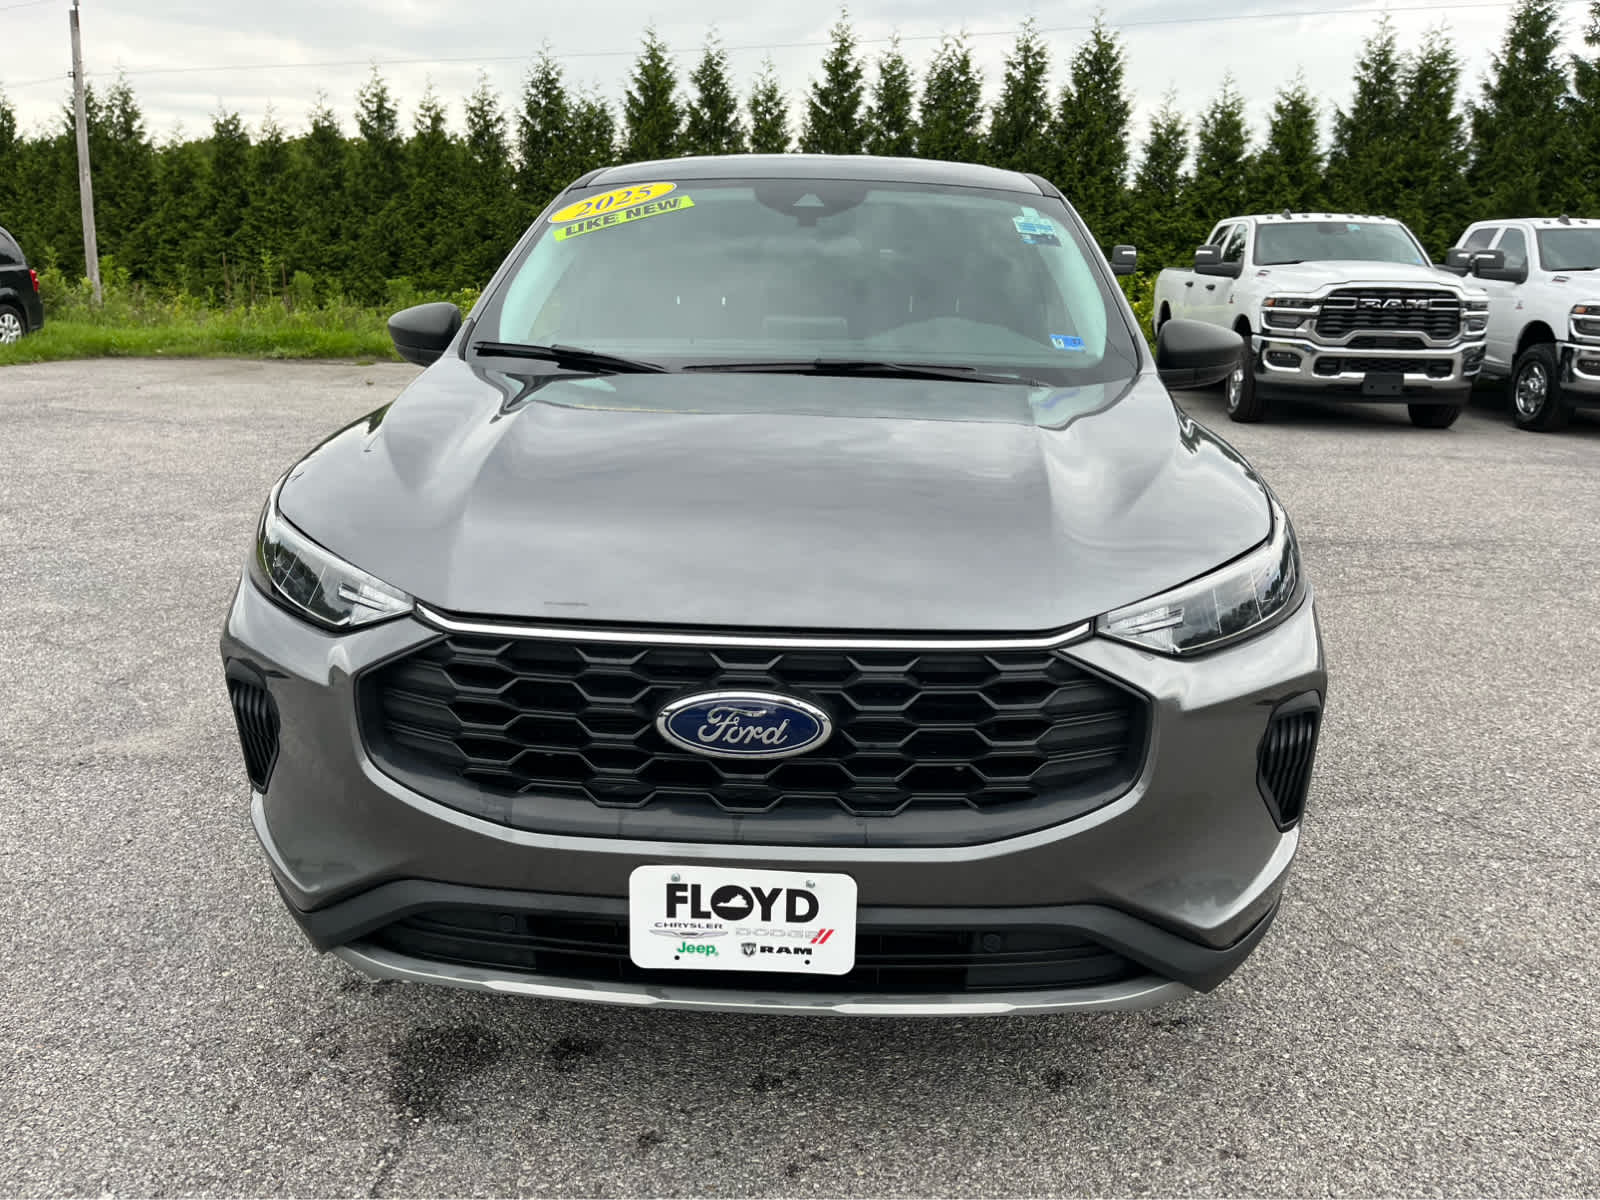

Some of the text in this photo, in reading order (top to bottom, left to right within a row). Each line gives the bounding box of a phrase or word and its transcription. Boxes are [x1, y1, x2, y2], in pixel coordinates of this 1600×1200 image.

[575, 185, 652, 217] 2025
[565, 198, 681, 236] LIKE NEW
[1359, 298, 1429, 310] RAM
[697, 706, 791, 745] Ford
[666, 883, 819, 923] FLOYD
[654, 921, 723, 930] CHRYSLER
[735, 928, 820, 938] DODGE
[759, 946, 813, 956] RAM
